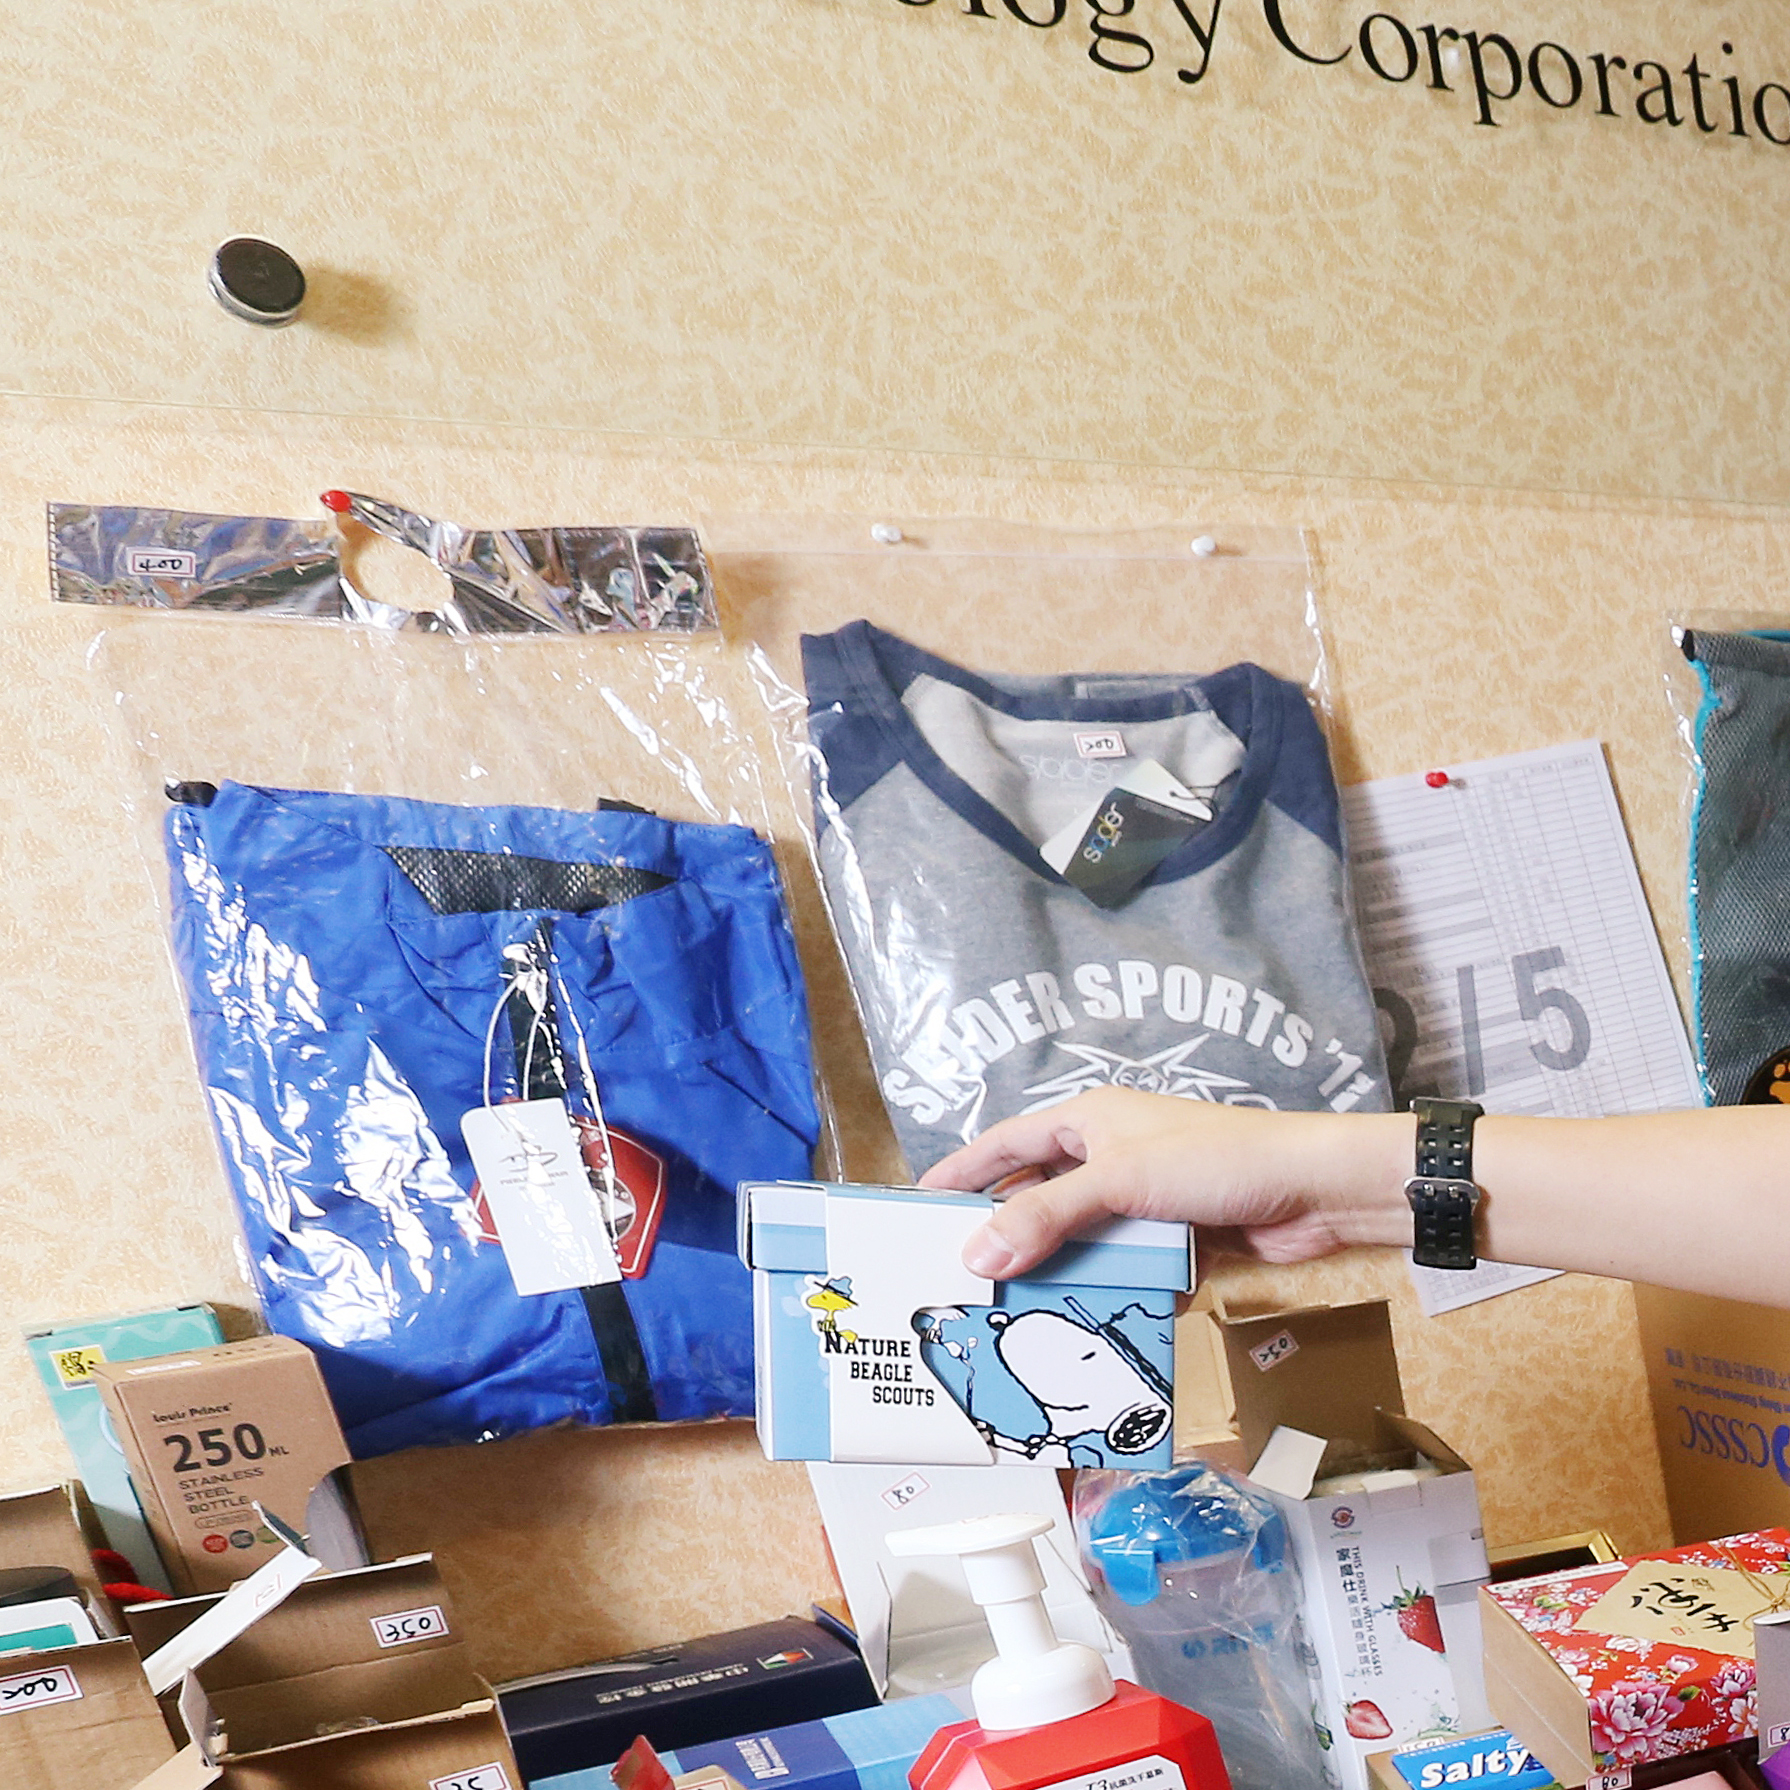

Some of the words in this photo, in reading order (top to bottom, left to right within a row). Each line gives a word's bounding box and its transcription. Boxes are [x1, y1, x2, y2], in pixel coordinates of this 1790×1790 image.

[1073, 960, 1314, 1068] SPORTS
[825, 1329, 911, 1358] NATURE
[851, 1361, 913, 1383] BEAGLE
[872, 1385, 935, 1407] SCOUTS
[163, 1422, 267, 1474] 250
[179, 1467, 265, 1490] STAINLESS
[184, 1486, 235, 1502] STEEL
[188, 1495, 249, 1515] BOTTLE
[1351, 1546, 1362, 1569] THIS
[1356, 1571, 1368, 1603] DRINK
[384, 1616, 431, 1641] 350
[1362, 1604, 1374, 1633] WITH
[1367, 1635, 1383, 1677] GLASSES
[1421, 1749, 1531, 1789] Salty
